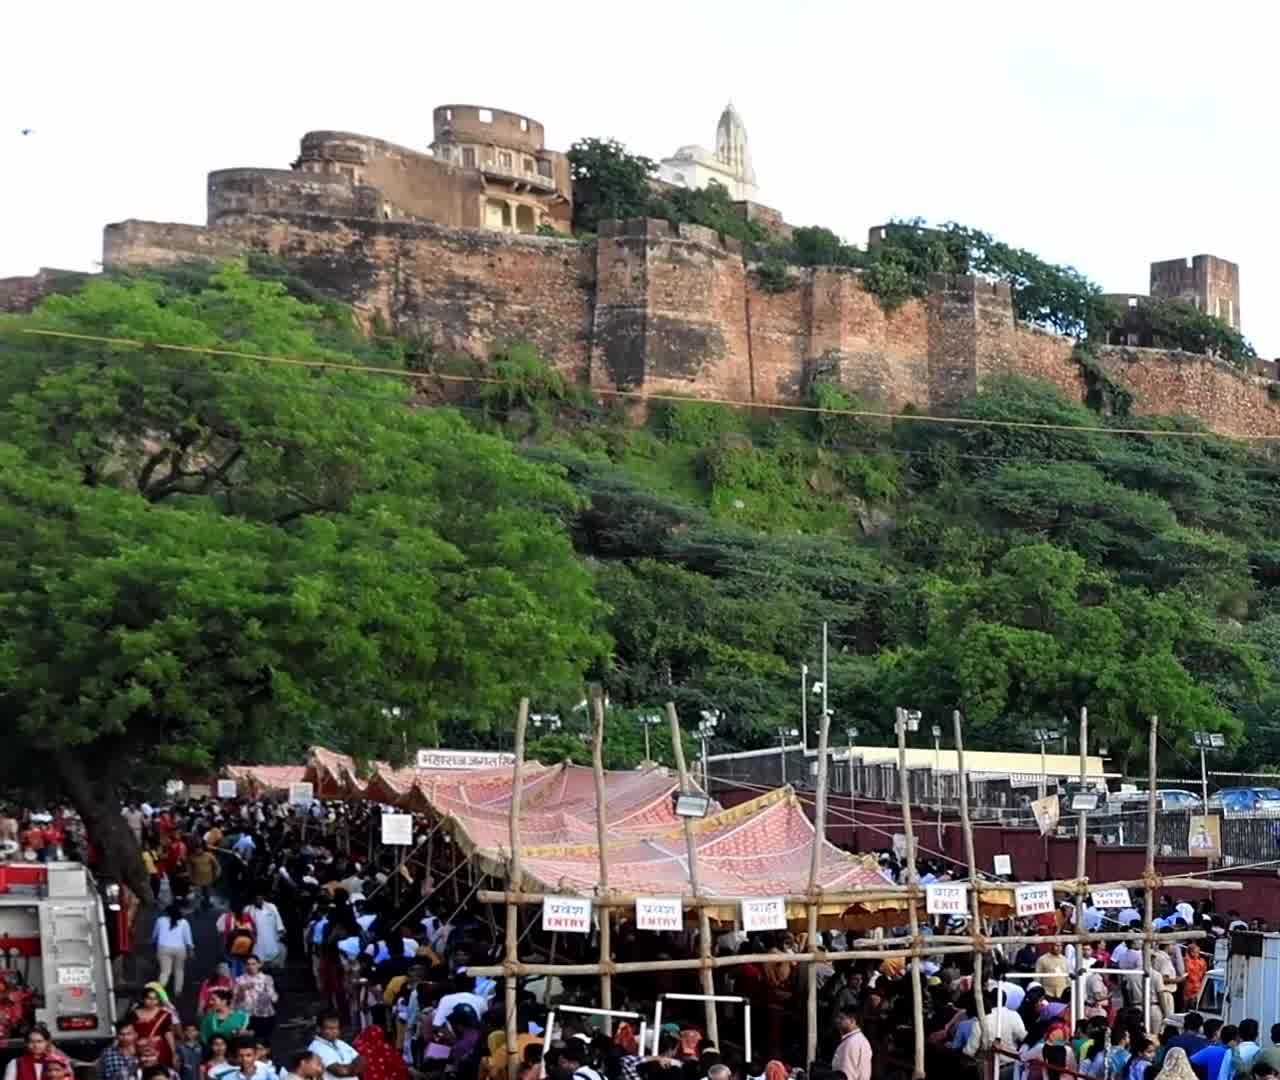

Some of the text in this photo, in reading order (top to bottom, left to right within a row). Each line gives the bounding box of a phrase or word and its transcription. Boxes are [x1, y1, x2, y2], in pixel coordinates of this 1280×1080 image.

[1020, 901, 1050, 914] ENTRY
[547, 918, 585, 929] ENTRY
[640, 917, 677, 927] ENTRY
